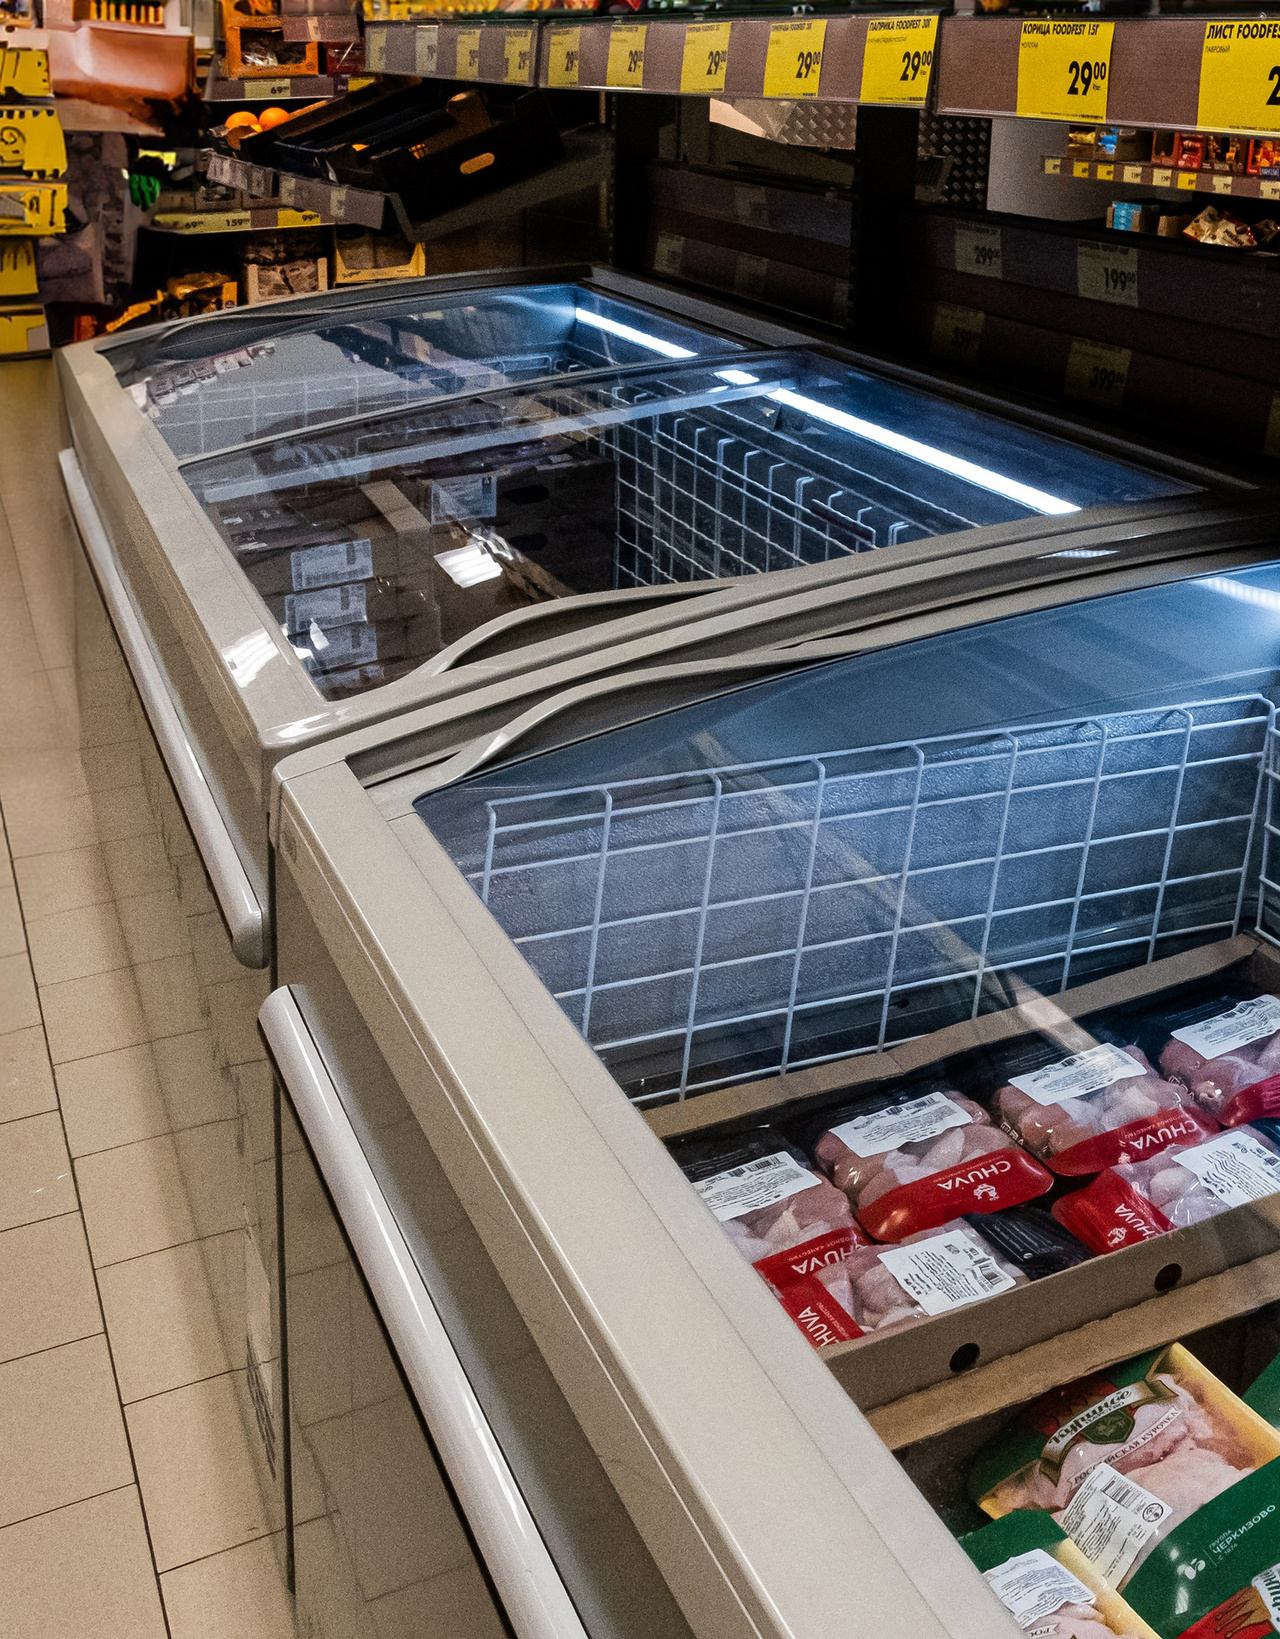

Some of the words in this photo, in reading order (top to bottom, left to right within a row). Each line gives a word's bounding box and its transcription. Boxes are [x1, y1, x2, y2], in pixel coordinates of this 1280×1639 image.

[868, 20, 895, 32] ПАПРИКА
[896, 18, 921, 30] FOODFEST
[1022, 23, 1050, 36] КОРИЦА
[1052, 24, 1086, 36] FOODFEST
[1087, 24, 1100, 36] 15Г
[1206, 24, 1234, 40] ЛИСТ
[796, 52, 812, 79] 29
[900, 51, 922, 82] 29
[1067, 61, 1093, 96] 29
[1104, 268, 1128, 292] 199
[1130, 1120, 1198, 1150] CHUVA
[937, 1160, 1012, 1190] CHUVA
[1114, 1203, 1156, 1238] HUVA
[797, 1306, 837, 1348] HUVA
[1142, 1411, 1178, 1442] КУРОЧКА
[1212, 1504, 1276, 1554] ЧЕРКИЗОВО
